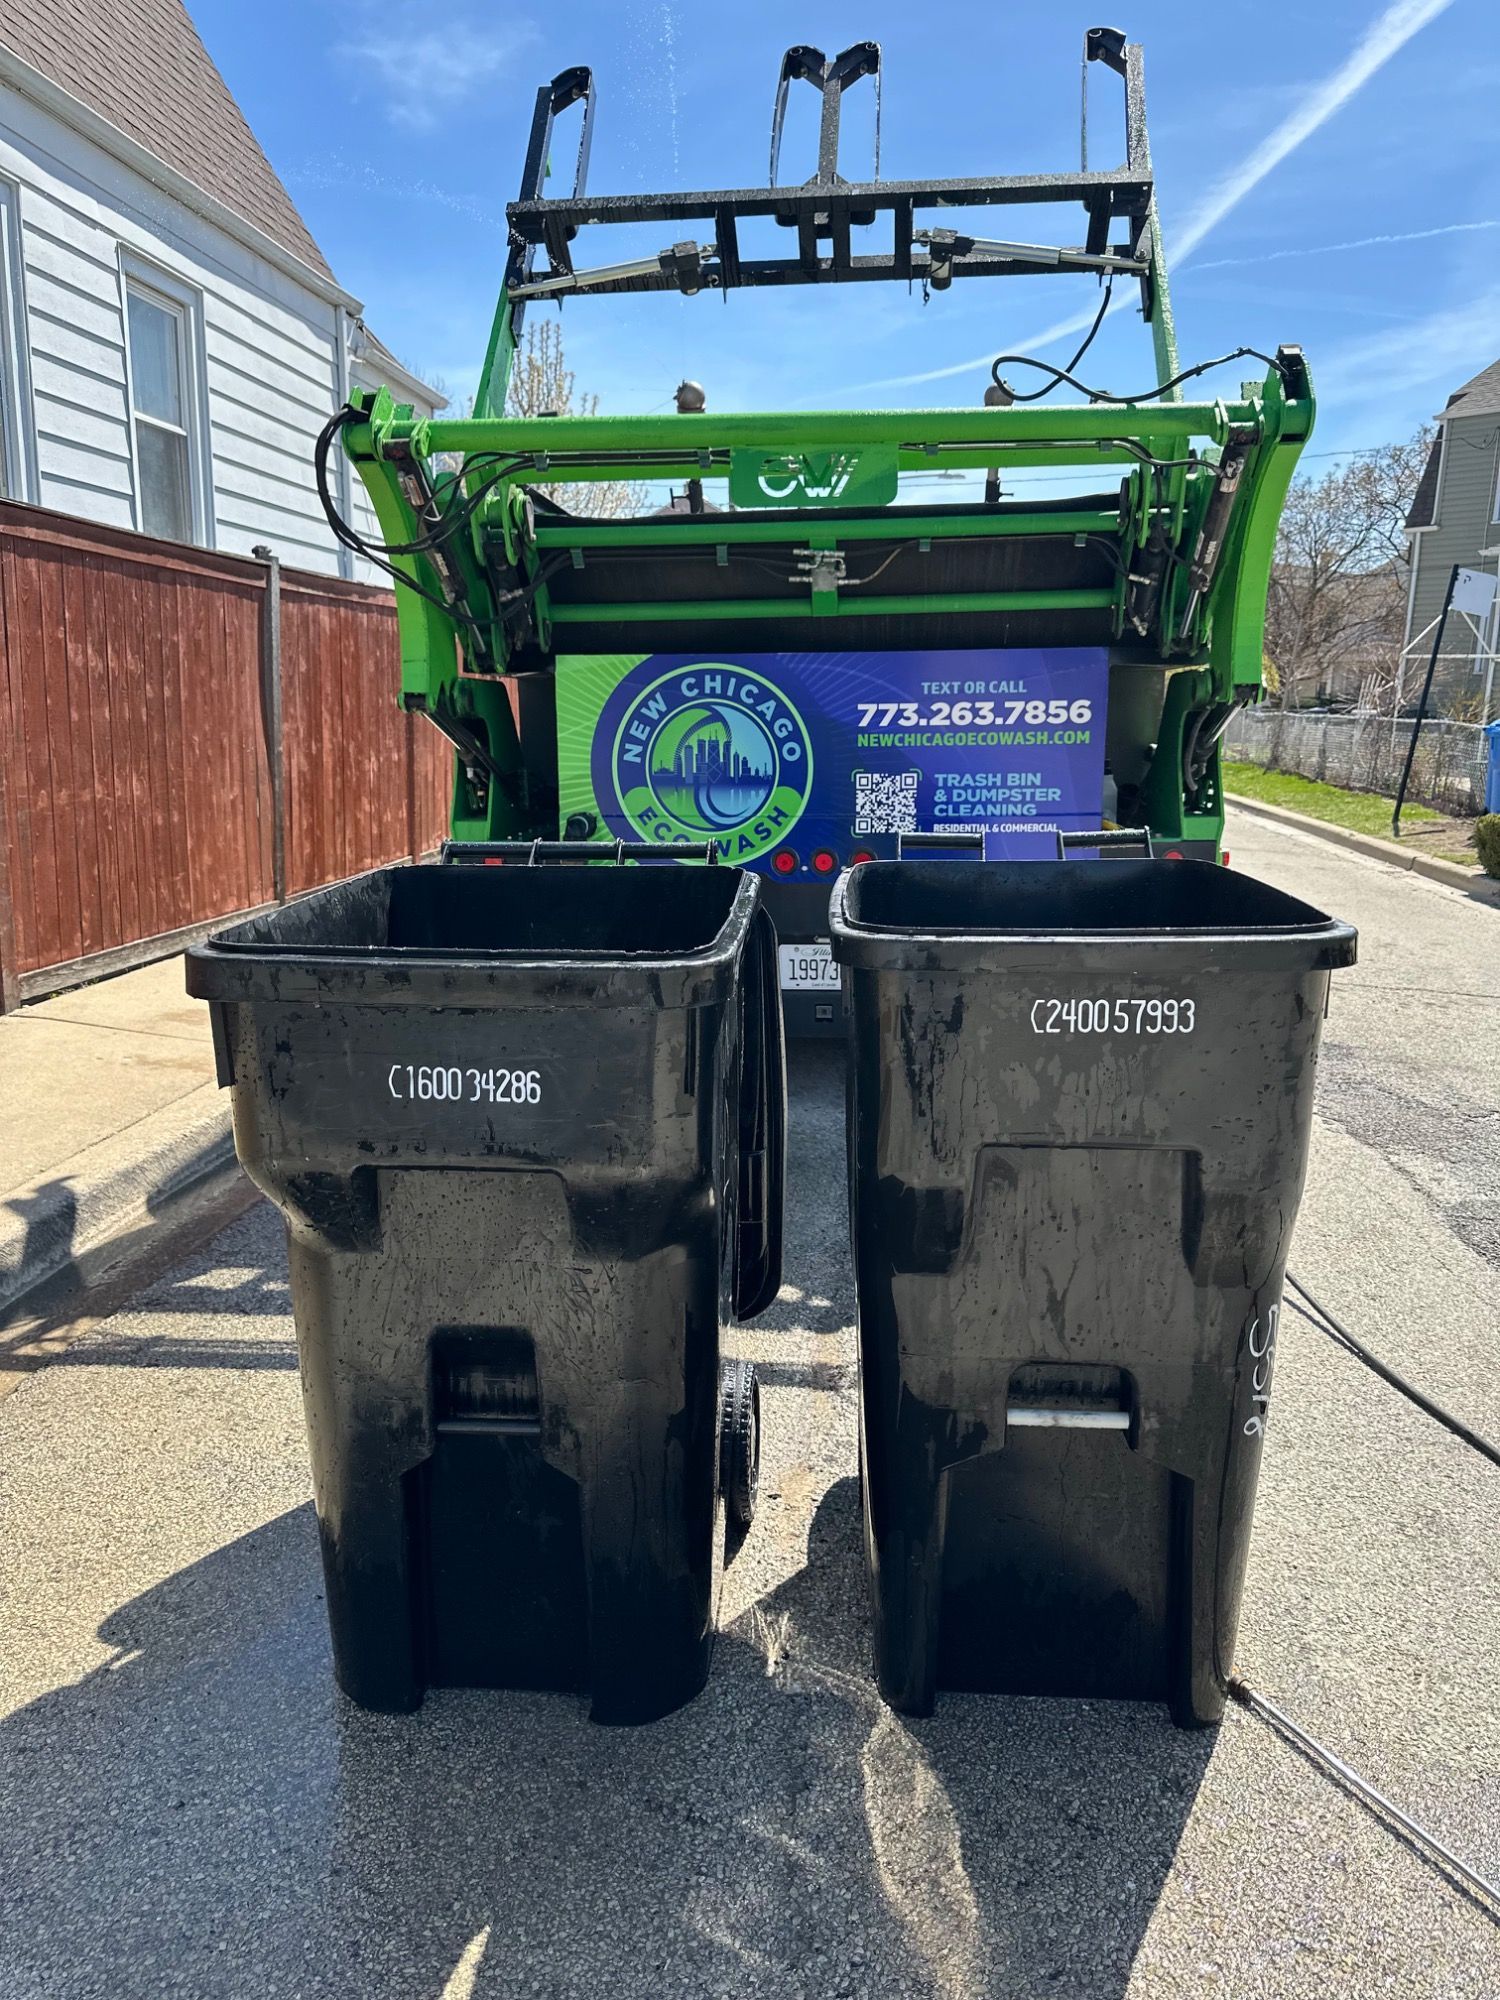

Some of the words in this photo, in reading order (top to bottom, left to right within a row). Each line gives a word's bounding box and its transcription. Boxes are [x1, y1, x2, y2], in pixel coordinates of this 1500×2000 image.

[921, 681, 961, 695] TEXT
[964, 681, 985, 694] OR
[989, 680, 1027, 694] CALL
[623, 691, 668, 763] NEW
[680, 674, 801, 762] CHICAGO
[857, 699, 1092, 727] 773.263.7856
[857, 730, 1091, 747] NEWCHICAGOECOWASH.COM
[934, 773, 1001, 787] TRASH
[1007, 772, 1042, 786] BIN
[934, 789, 948, 802] &
[952, 788, 1061, 802] DUMPSTER
[934, 803, 1037, 817] CLEANING
[933, 823, 990, 833] RESIDENTIAL
[992, 823, 999, 833] &
[1000, 823, 1058, 833] COMMERCIAL
